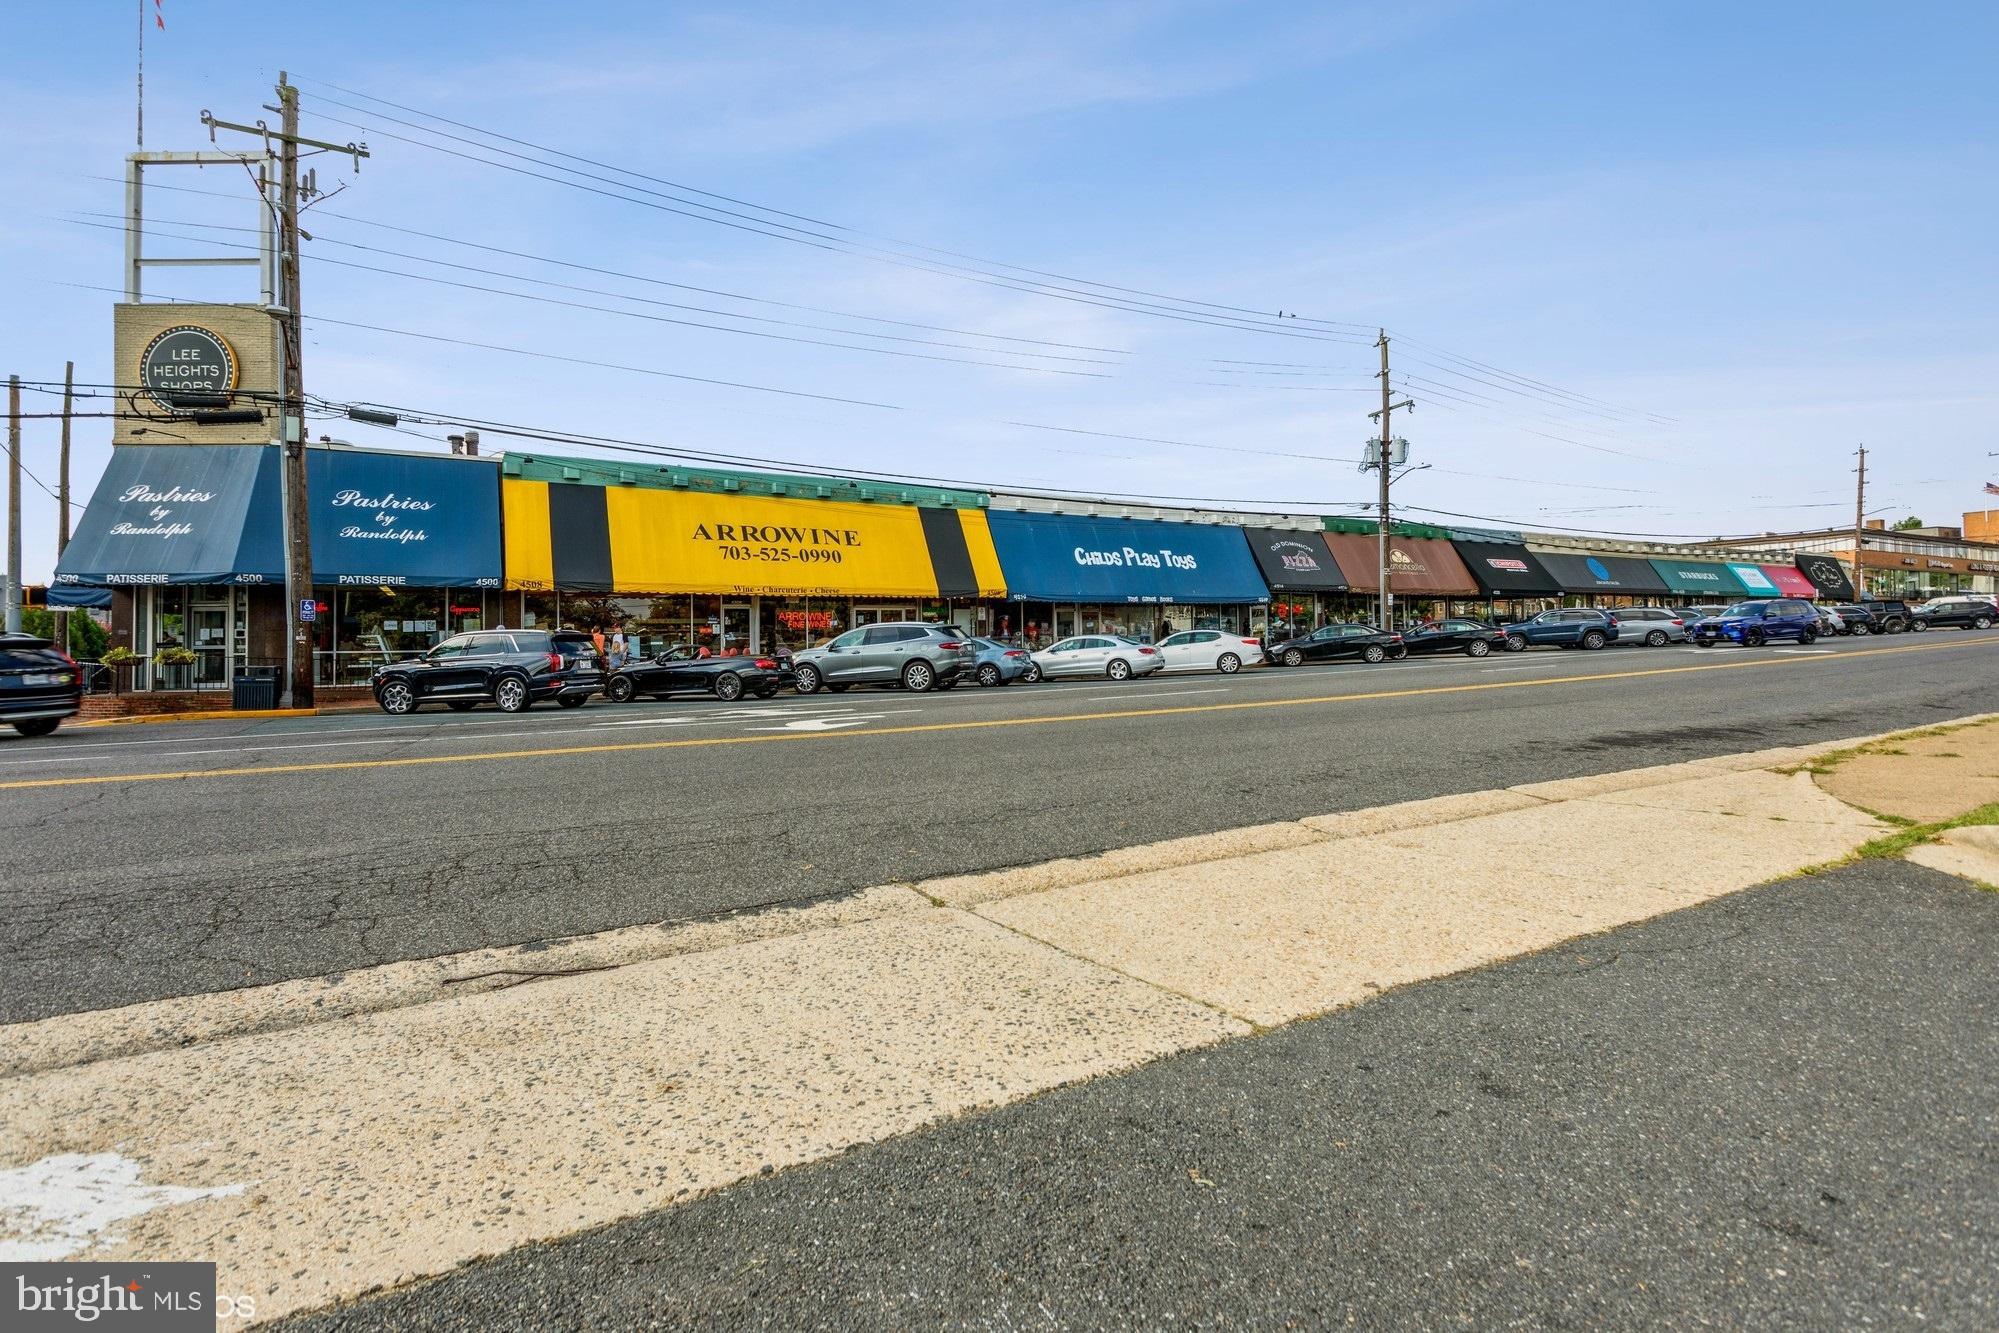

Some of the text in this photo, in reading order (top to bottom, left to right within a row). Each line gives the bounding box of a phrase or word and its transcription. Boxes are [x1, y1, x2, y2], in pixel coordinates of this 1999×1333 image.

[172, 349, 201, 360] LEE
[154, 365, 220, 377] HEIGHTS
[119, 484, 217, 503] Pastries
[332, 489, 436, 511] Pastries
[149, 505, 173, 521] by
[375, 511, 398, 527] by
[110, 522, 194, 539] Randolph
[339, 525, 429, 544] Randolph
[692, 523, 861, 547] ARROWINE
[1270, 541, 1313, 553] OLD DOMINION
[718, 545, 842, 564] 703-525-0990
[1281, 555, 1317, 568] PIZZA
[106, 574, 169, 584] PATISSERIE
[235, 574, 263, 583] 4500
[339, 575, 406, 585] PATISSERIE
[475, 578, 499, 586] 4500
[520, 580, 543, 588] 4508
[733, 585, 754, 593] Wine
[762, 586, 807, 594] Charcuterie
[778, 611, 832, 621] ARROWINE
[787, 620, 832, 628] FINE WINES
